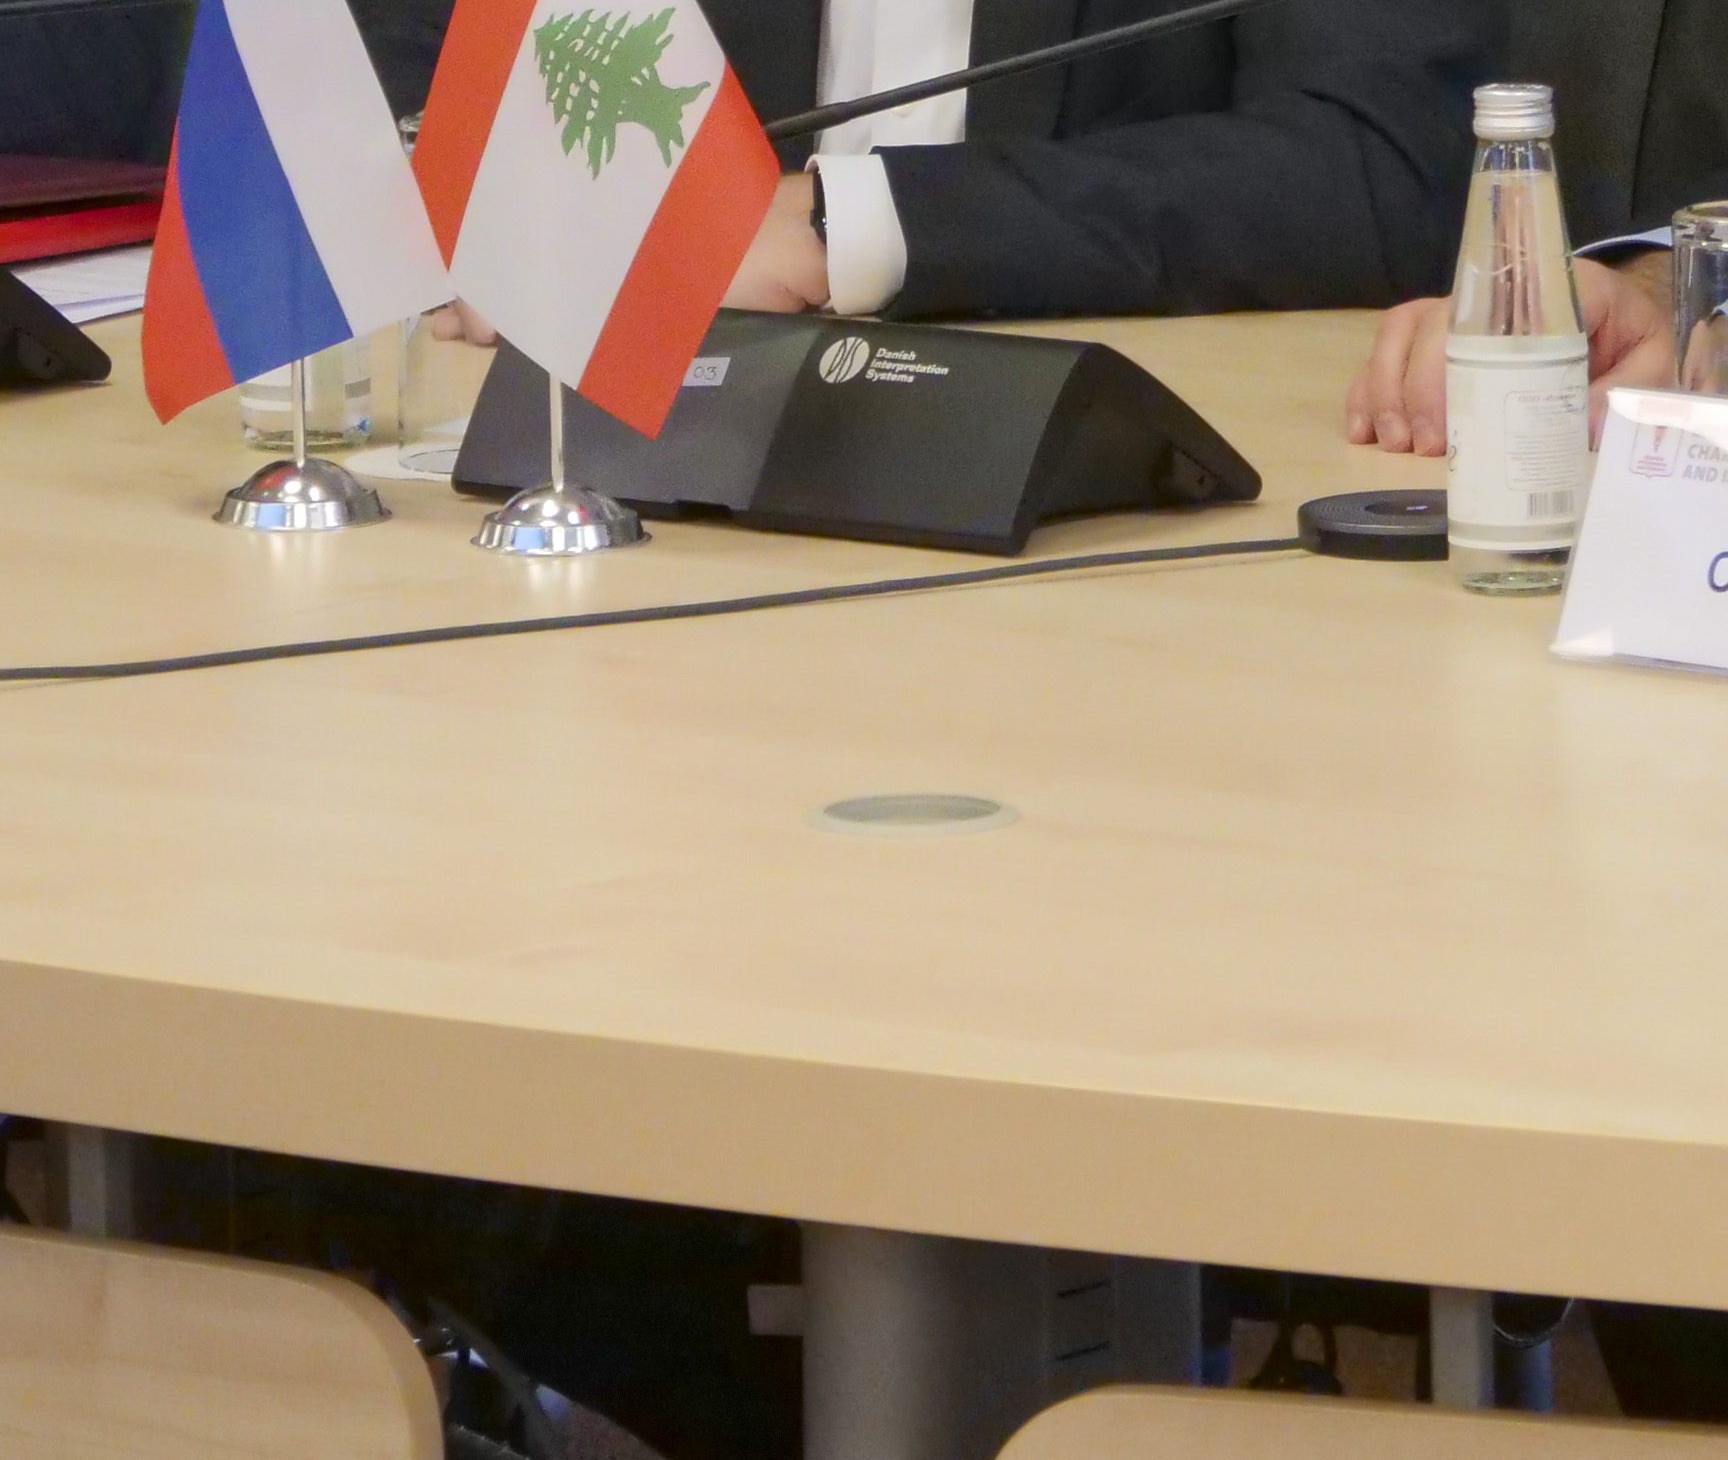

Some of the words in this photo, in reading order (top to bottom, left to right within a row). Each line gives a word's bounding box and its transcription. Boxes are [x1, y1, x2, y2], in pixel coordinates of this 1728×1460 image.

[875, 347, 917, 361] Danish
[869, 358, 950, 376] Interpretation
[864, 368, 916, 384] Systems
[1681, 464, 1719, 483] AND
